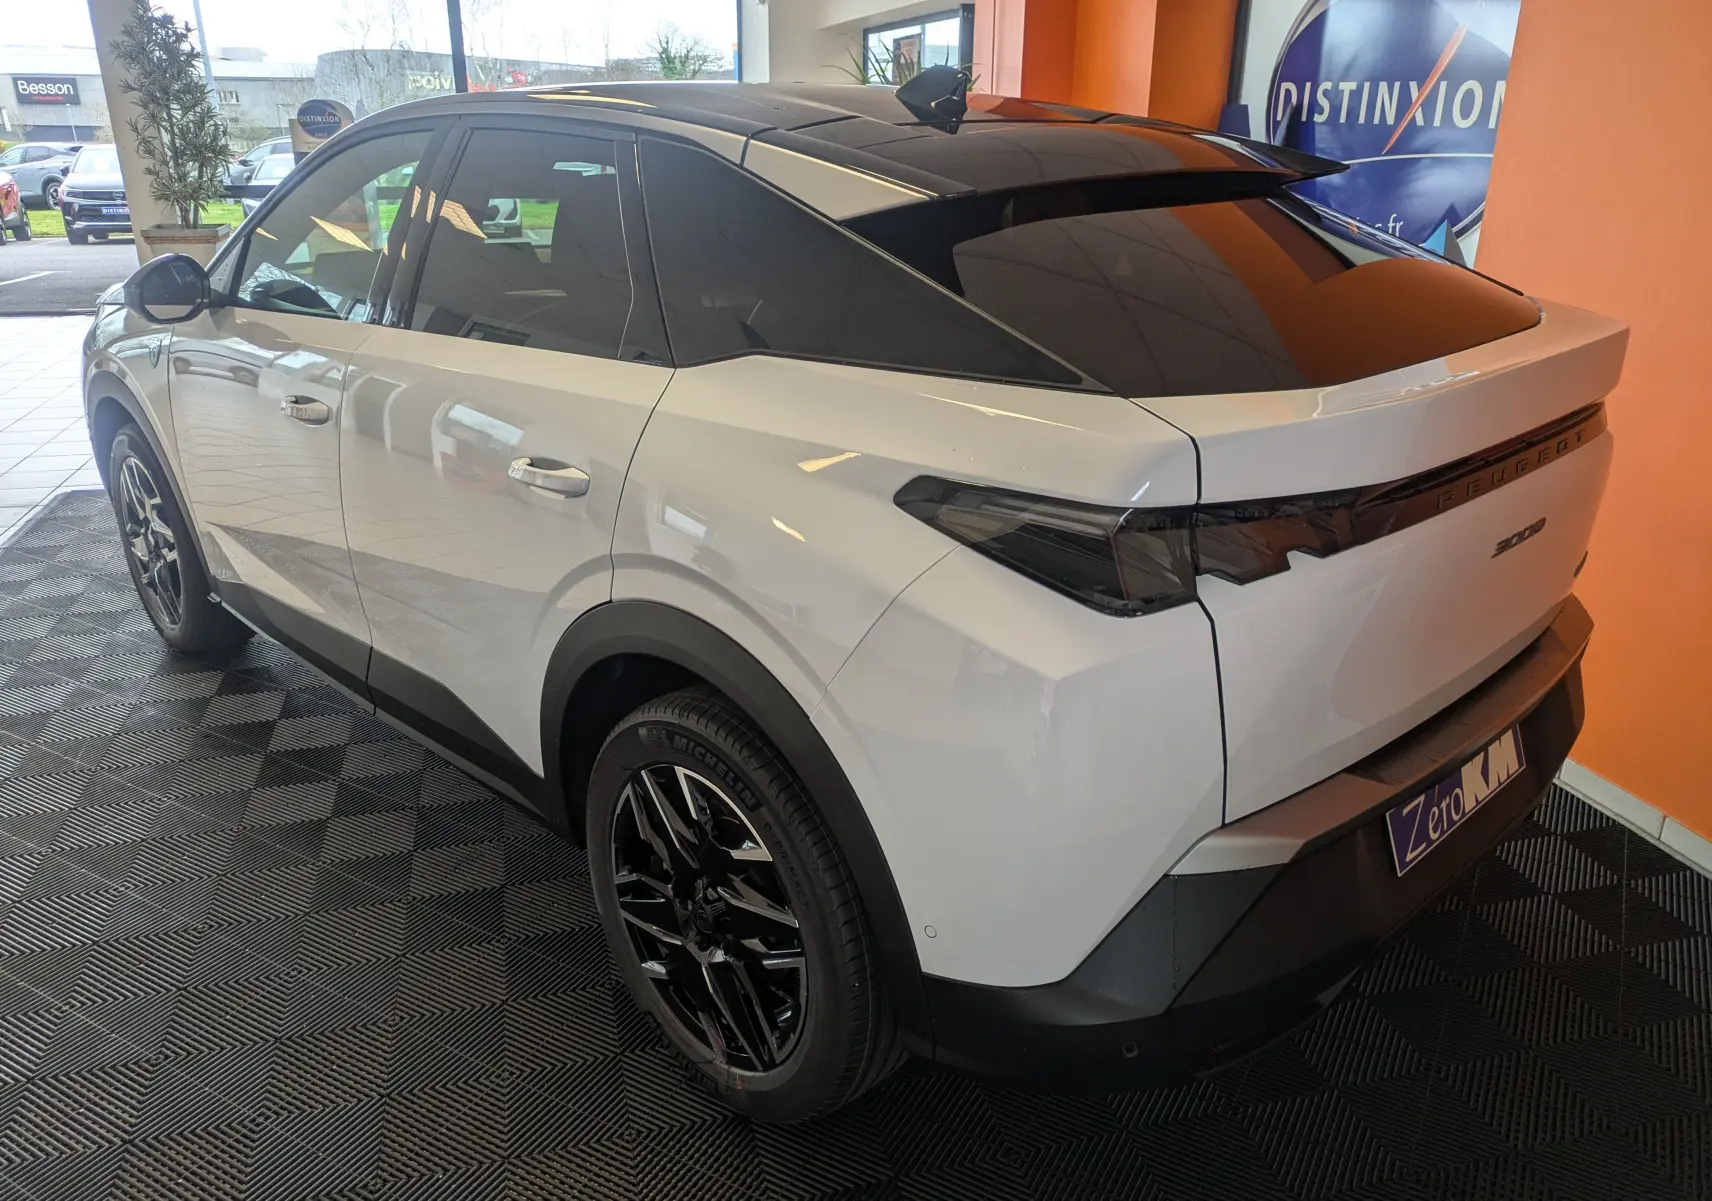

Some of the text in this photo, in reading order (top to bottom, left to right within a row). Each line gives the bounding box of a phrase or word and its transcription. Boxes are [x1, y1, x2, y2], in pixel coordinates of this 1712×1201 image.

[17, 80, 74, 94] Besson
[299, 115, 340, 123] DISTINXION
[1436, 428, 1587, 512] PEUGEOT
[1490, 516, 1547, 559] 3008
[673, 735, 758, 807] MICHELIN
